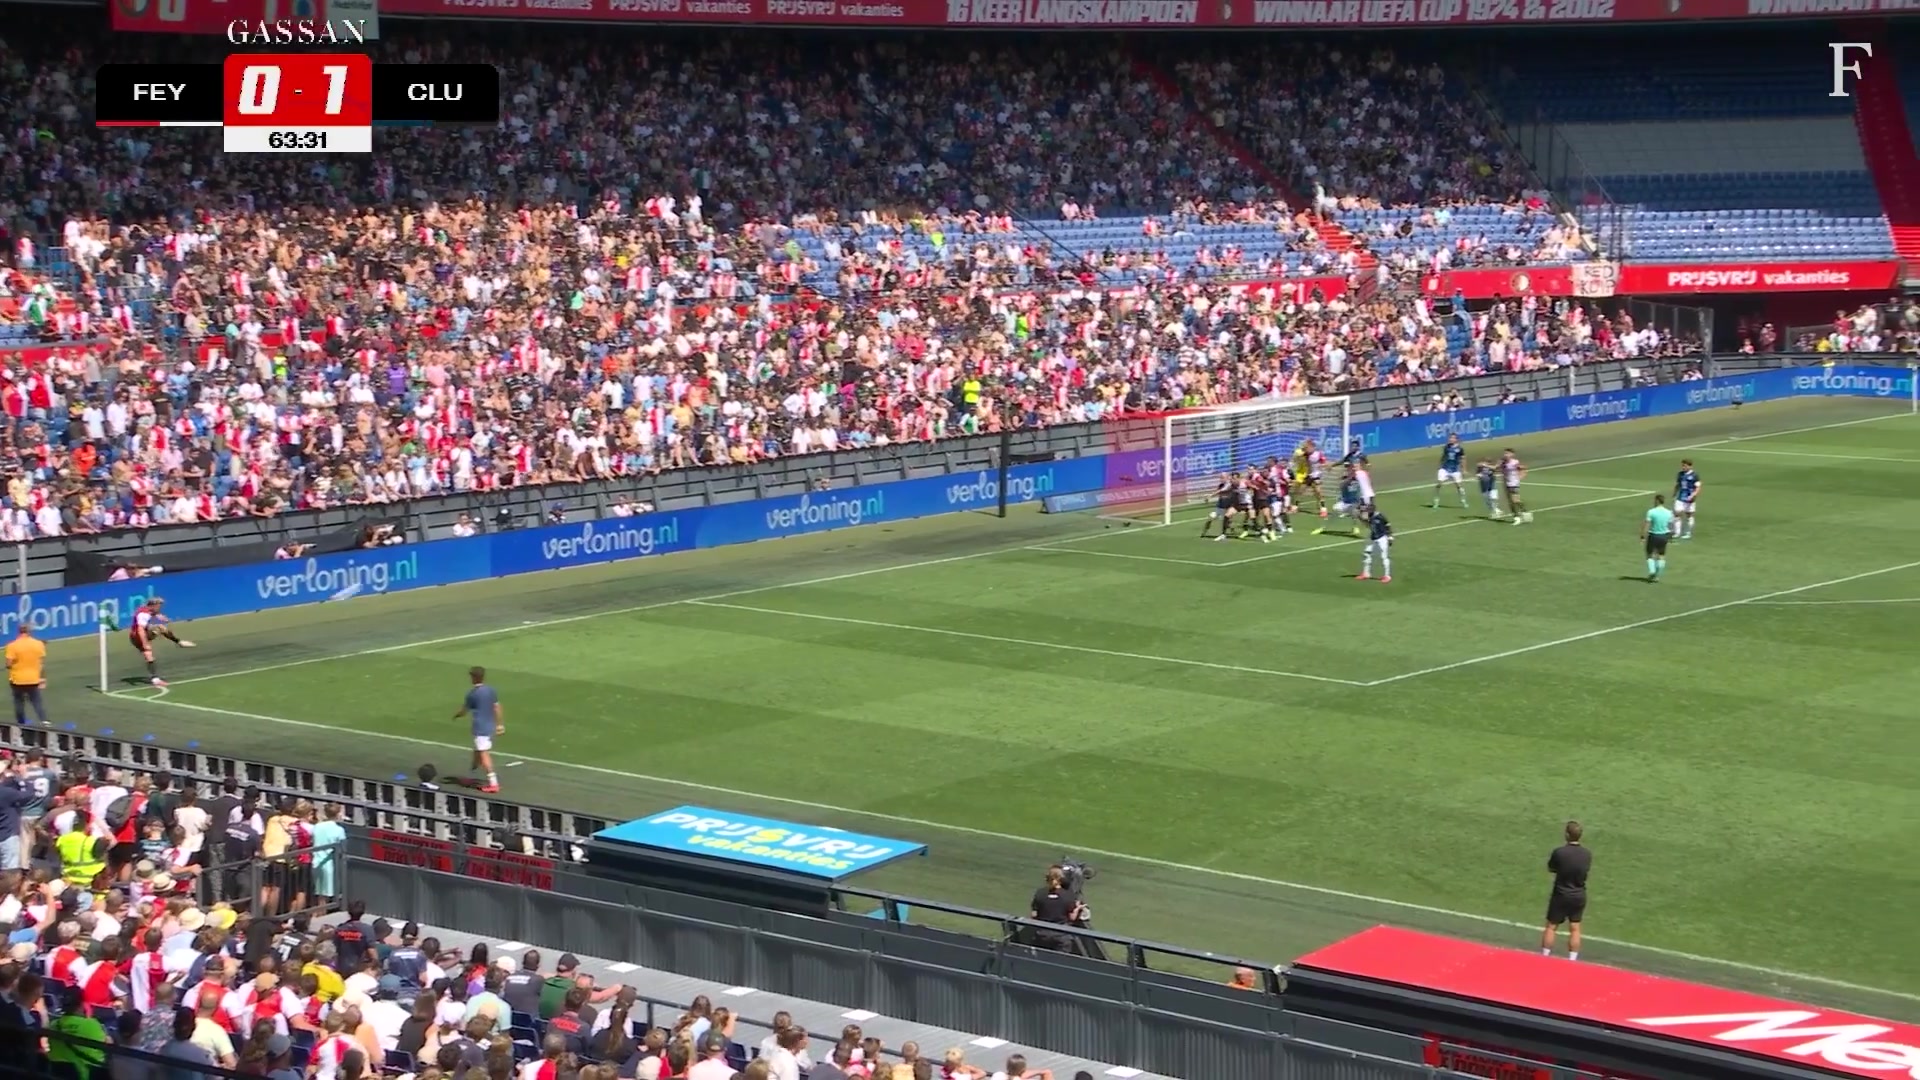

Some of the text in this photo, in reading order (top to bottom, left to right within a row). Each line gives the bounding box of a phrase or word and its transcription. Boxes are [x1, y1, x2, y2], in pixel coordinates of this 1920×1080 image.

[840, 3, 904, 17] vakanties
[946, 1, 1198, 23] 16 KEER LANDSKAMPIOEN
[1253, 0, 1359, 23] WINNAAR
[1361, 0, 1415, 22] UEFA
[1418, 0, 1461, 21] CUP
[1465, 0, 1520, 21] 1974
[1548, 0, 1615, 19] 2002
[1763, 268, 1850, 285] vakanties
[1687, 378, 1755, 405] verloning.nl
[1566, 392, 1642, 420] verloning.nl
[1425, 410, 1505, 439] verloning.nl
[766, 489, 884, 529] verloning.nl
[542, 517, 679, 559] verloning.nl
[256, 551, 418, 599] verloning.nl
[687, 834, 856, 871] vakanties
[1626, 1010, 1920, 1080] Me
